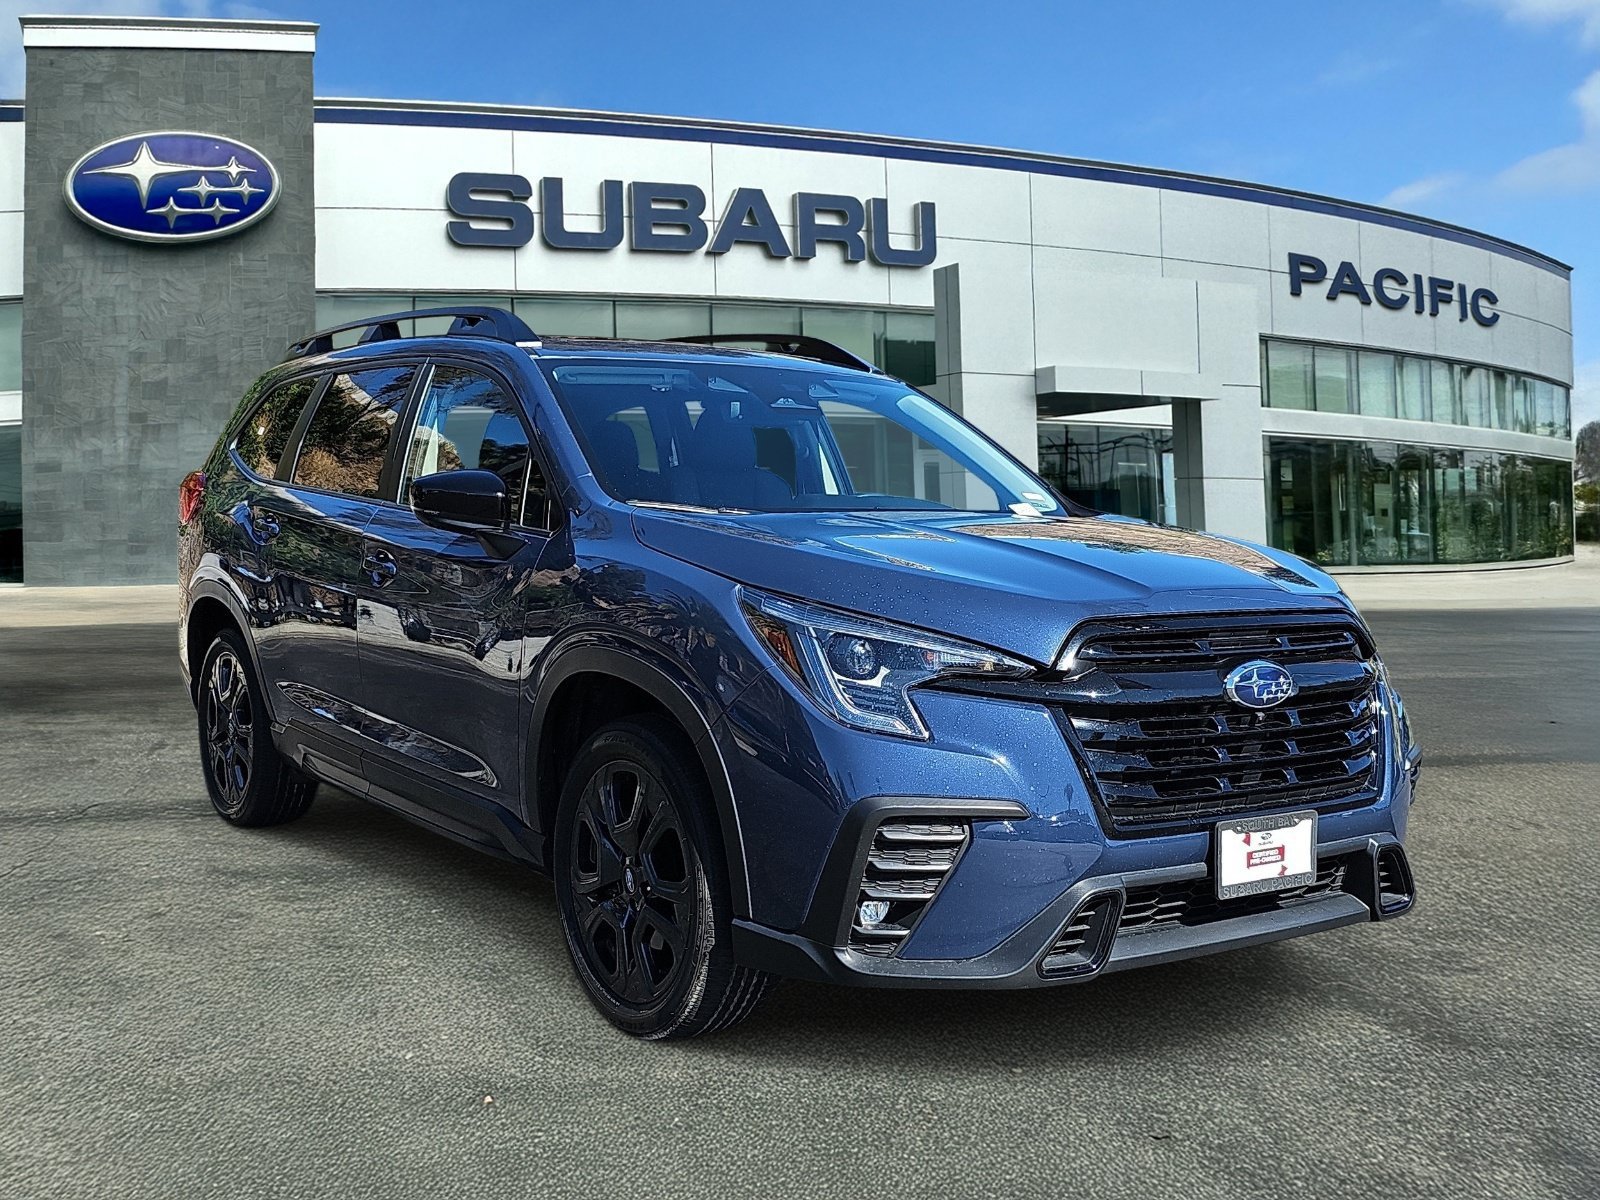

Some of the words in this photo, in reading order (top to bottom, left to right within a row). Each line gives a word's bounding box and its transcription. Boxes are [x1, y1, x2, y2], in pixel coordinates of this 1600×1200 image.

[446, 172, 937, 268] SUBARU
[1288, 252, 1500, 327] PACIFIC
[1242, 818, 1275, 831] SOUTH
[1223, 881, 1268, 898] SUBARU
[1271, 873, 1313, 891] PACIFIC
